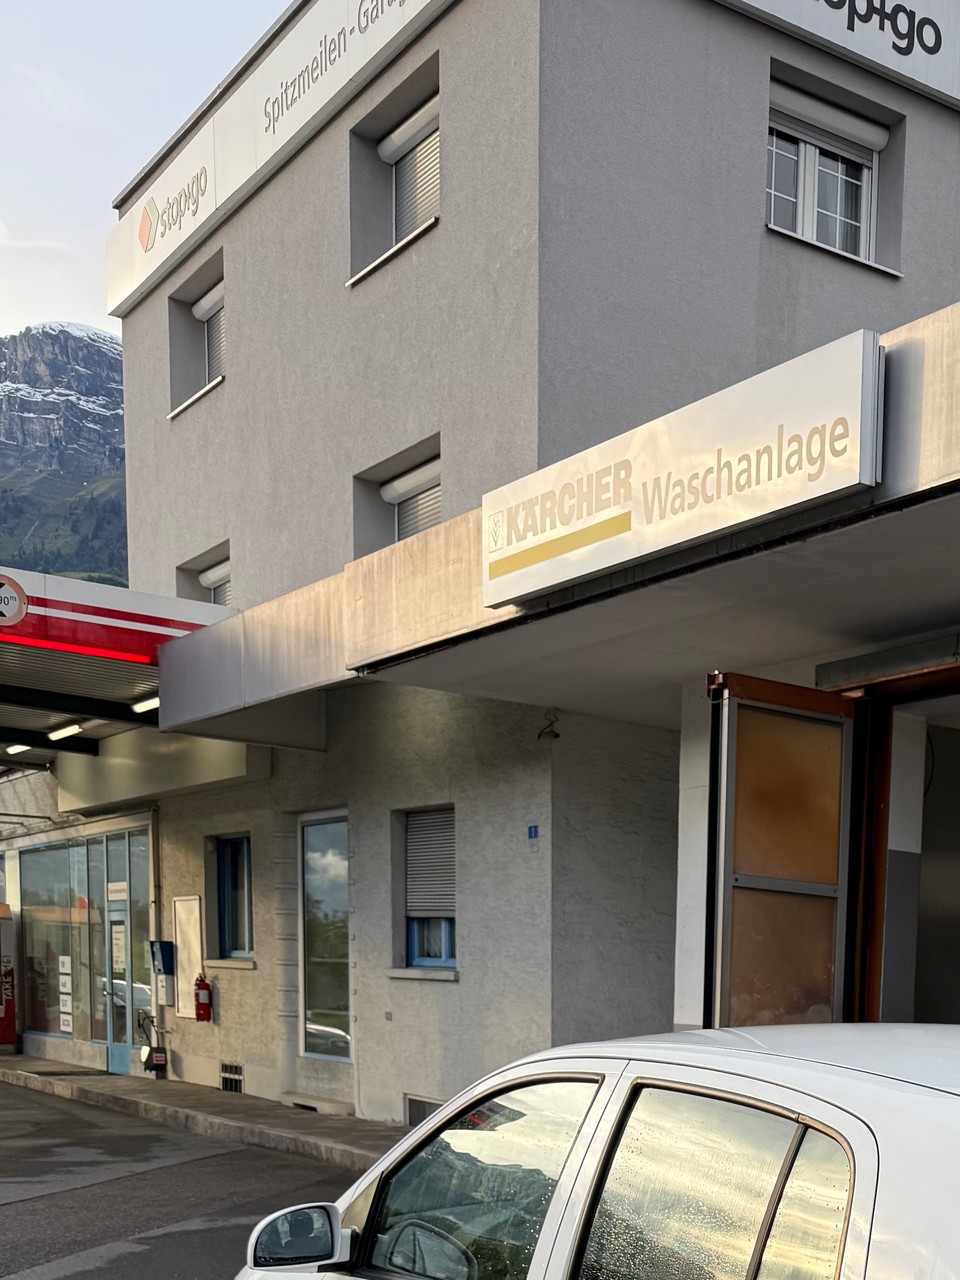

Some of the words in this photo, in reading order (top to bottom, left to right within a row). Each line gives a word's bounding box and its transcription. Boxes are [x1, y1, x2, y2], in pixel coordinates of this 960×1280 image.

[265, 26, 347, 134] Spitzmeilen
[506, 458, 633, 547] KÄRCHER
[642, 416, 850, 525] Waschanlage
